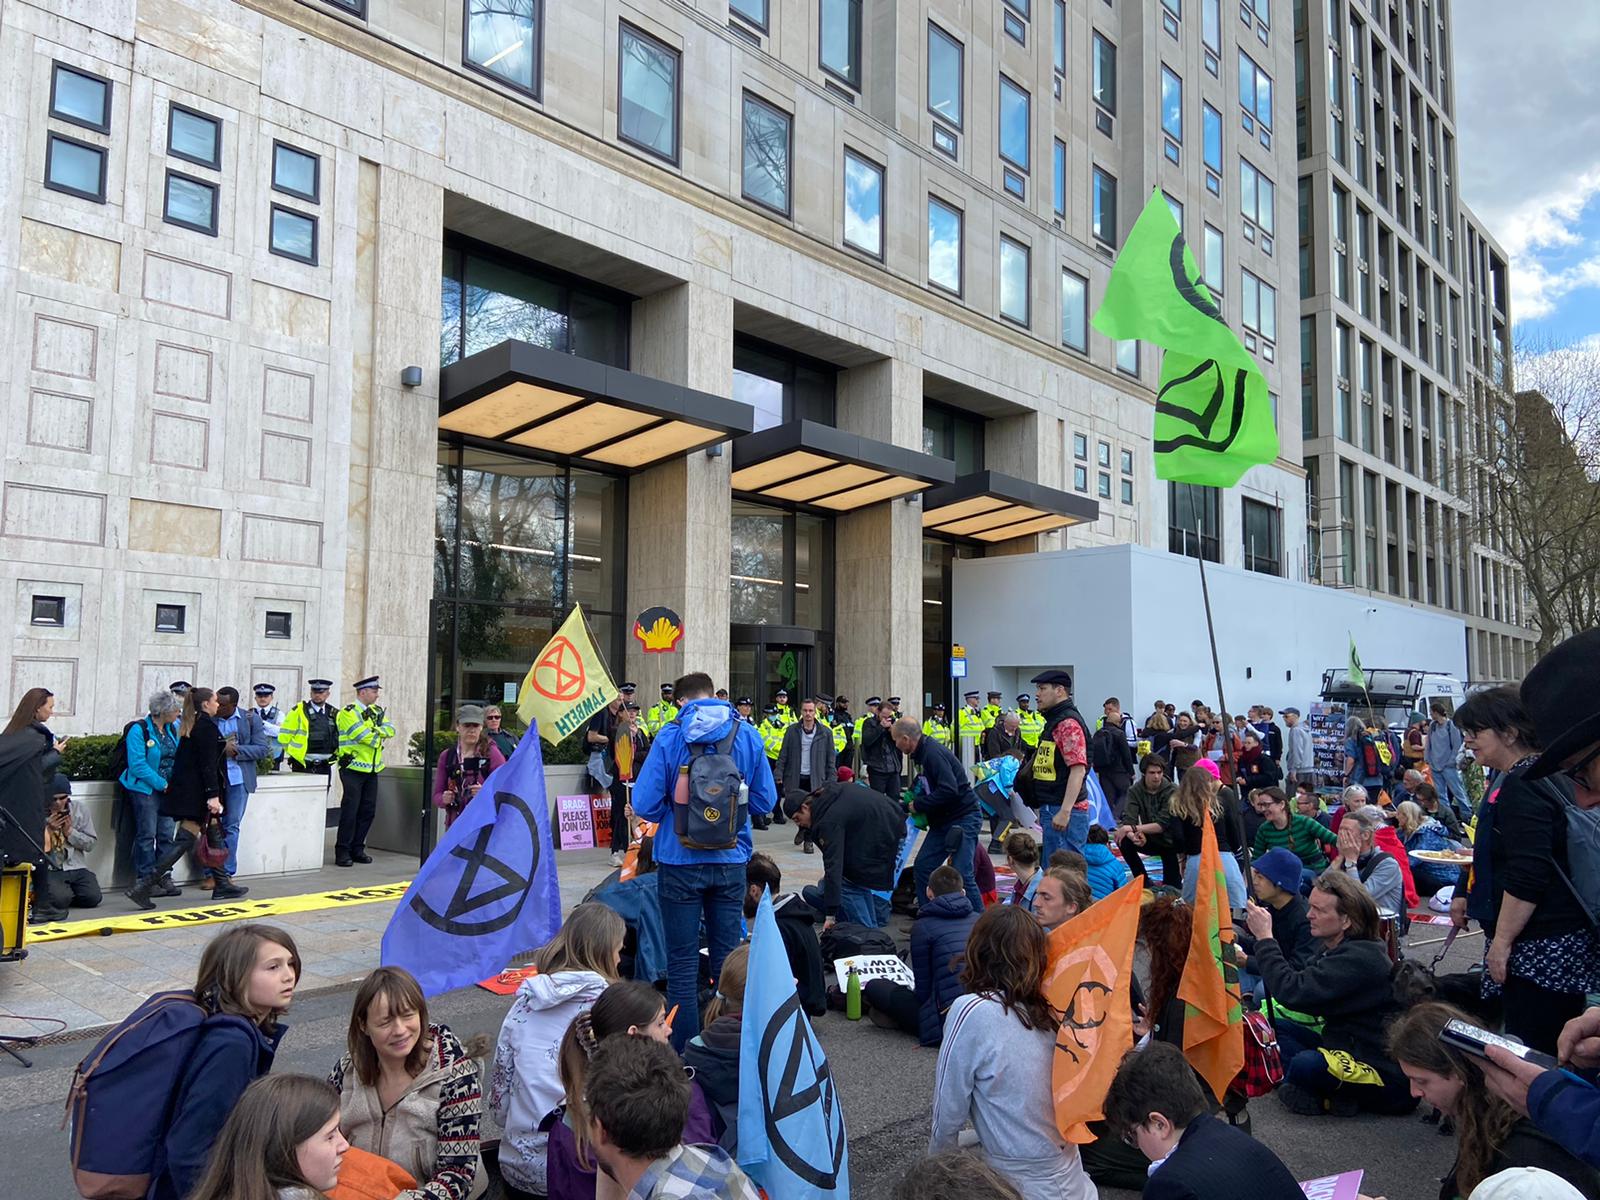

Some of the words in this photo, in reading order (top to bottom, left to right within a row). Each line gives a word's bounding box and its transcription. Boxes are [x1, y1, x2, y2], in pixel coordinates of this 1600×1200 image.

[1039, 746, 1050, 757] OVE
[1033, 765, 1053, 774] CTION
[562, 799, 586, 810] BRAD:
[562, 811, 589, 821] PLEASE
[561, 821, 578, 832] JOIN
[579, 820, 592, 831] US!
